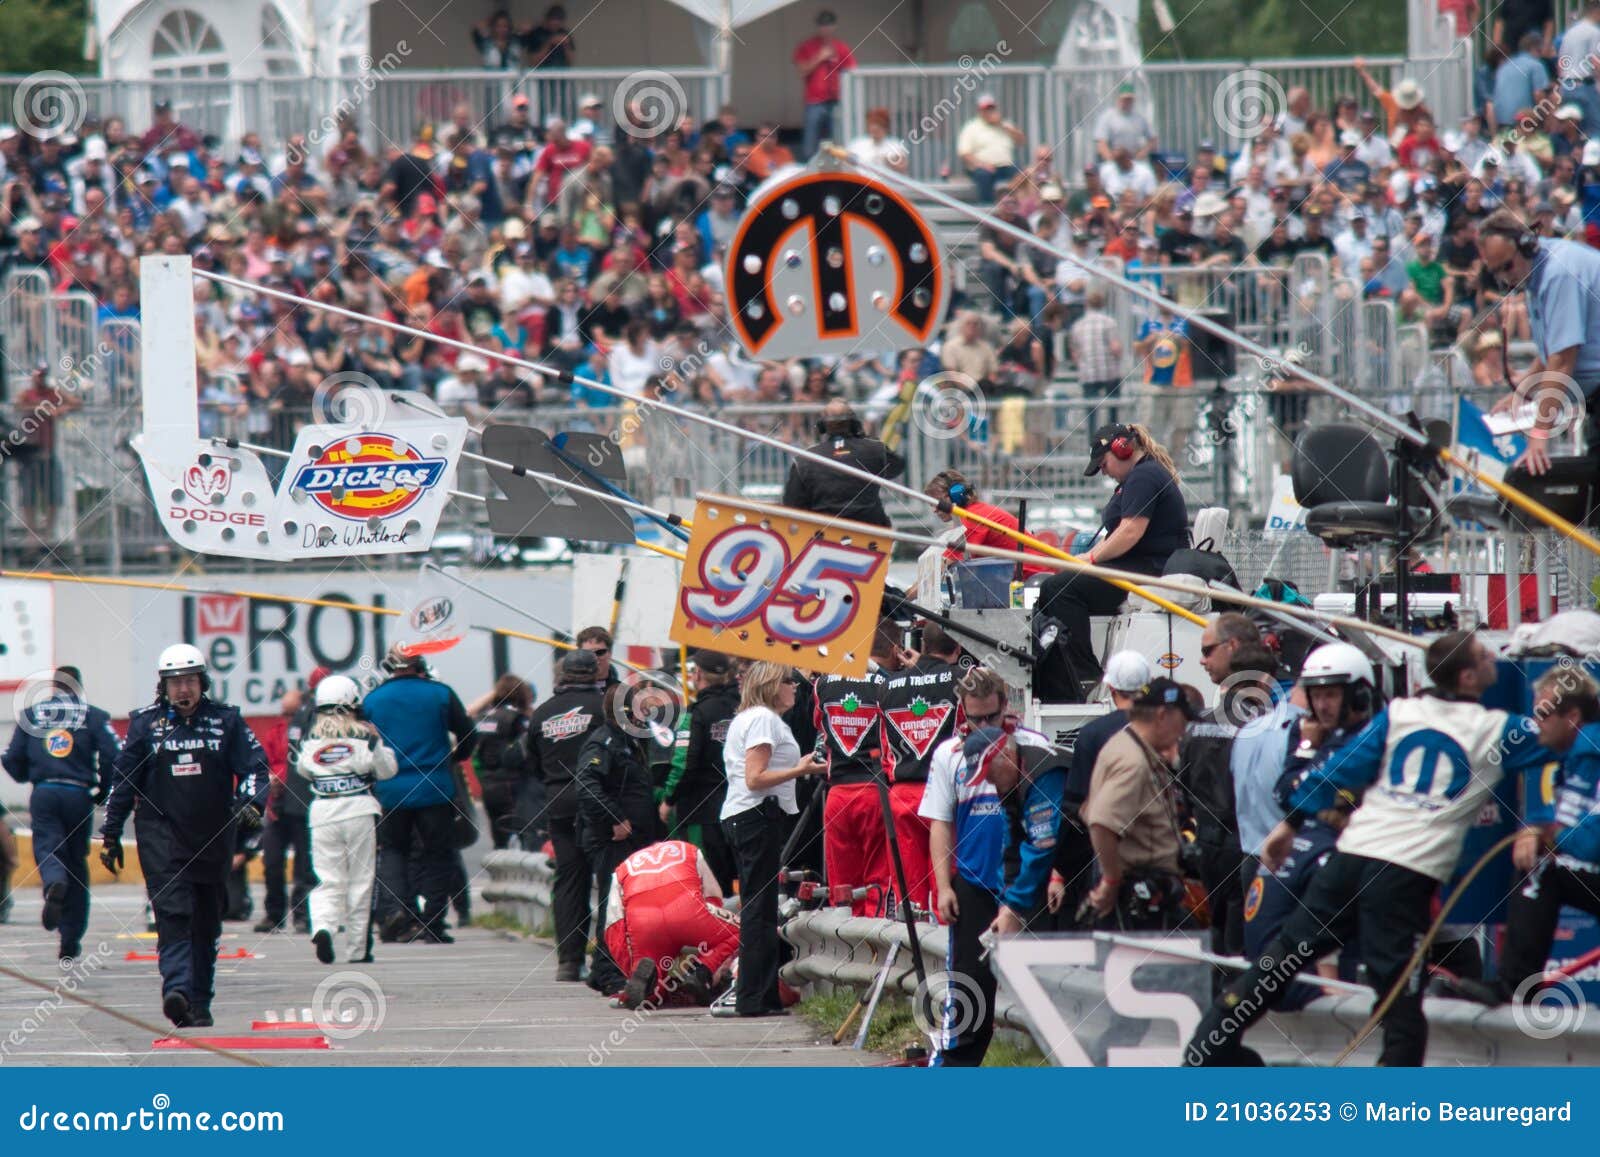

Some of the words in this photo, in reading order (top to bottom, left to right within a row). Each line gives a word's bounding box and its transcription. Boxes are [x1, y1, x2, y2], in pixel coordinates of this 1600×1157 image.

[306, 463, 430, 488] Dickies
[170, 506, 265, 527] DODGE
[681, 523, 888, 647] 95
[888, 677, 906, 690] TOW
